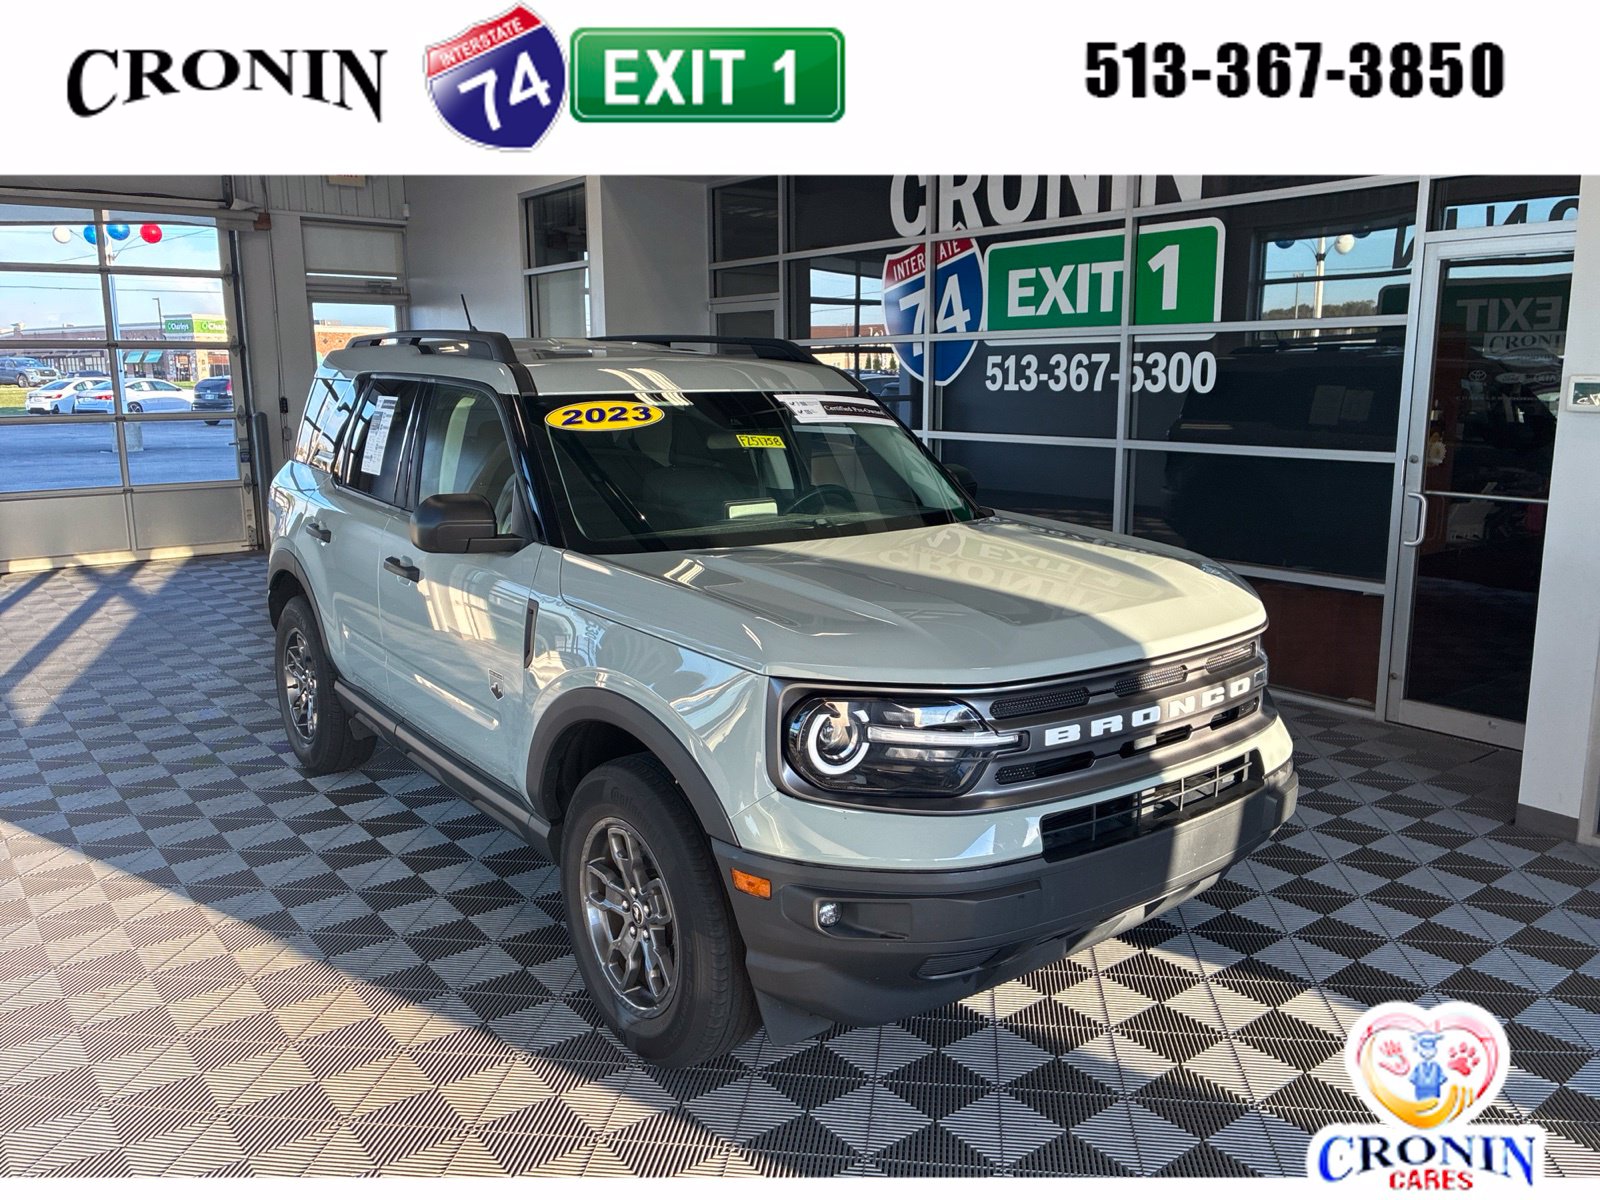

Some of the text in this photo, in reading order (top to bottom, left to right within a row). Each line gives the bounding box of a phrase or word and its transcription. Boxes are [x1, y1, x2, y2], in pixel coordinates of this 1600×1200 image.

[893, 238, 961, 281] INTERATE
[1007, 244, 1180, 318] EXIT 1
[899, 274, 971, 357] 74
[985, 351, 1217, 394] 513-367-5300
[562, 406, 652, 426] 2023
[1045, 677, 1251, 746] BRONCO
